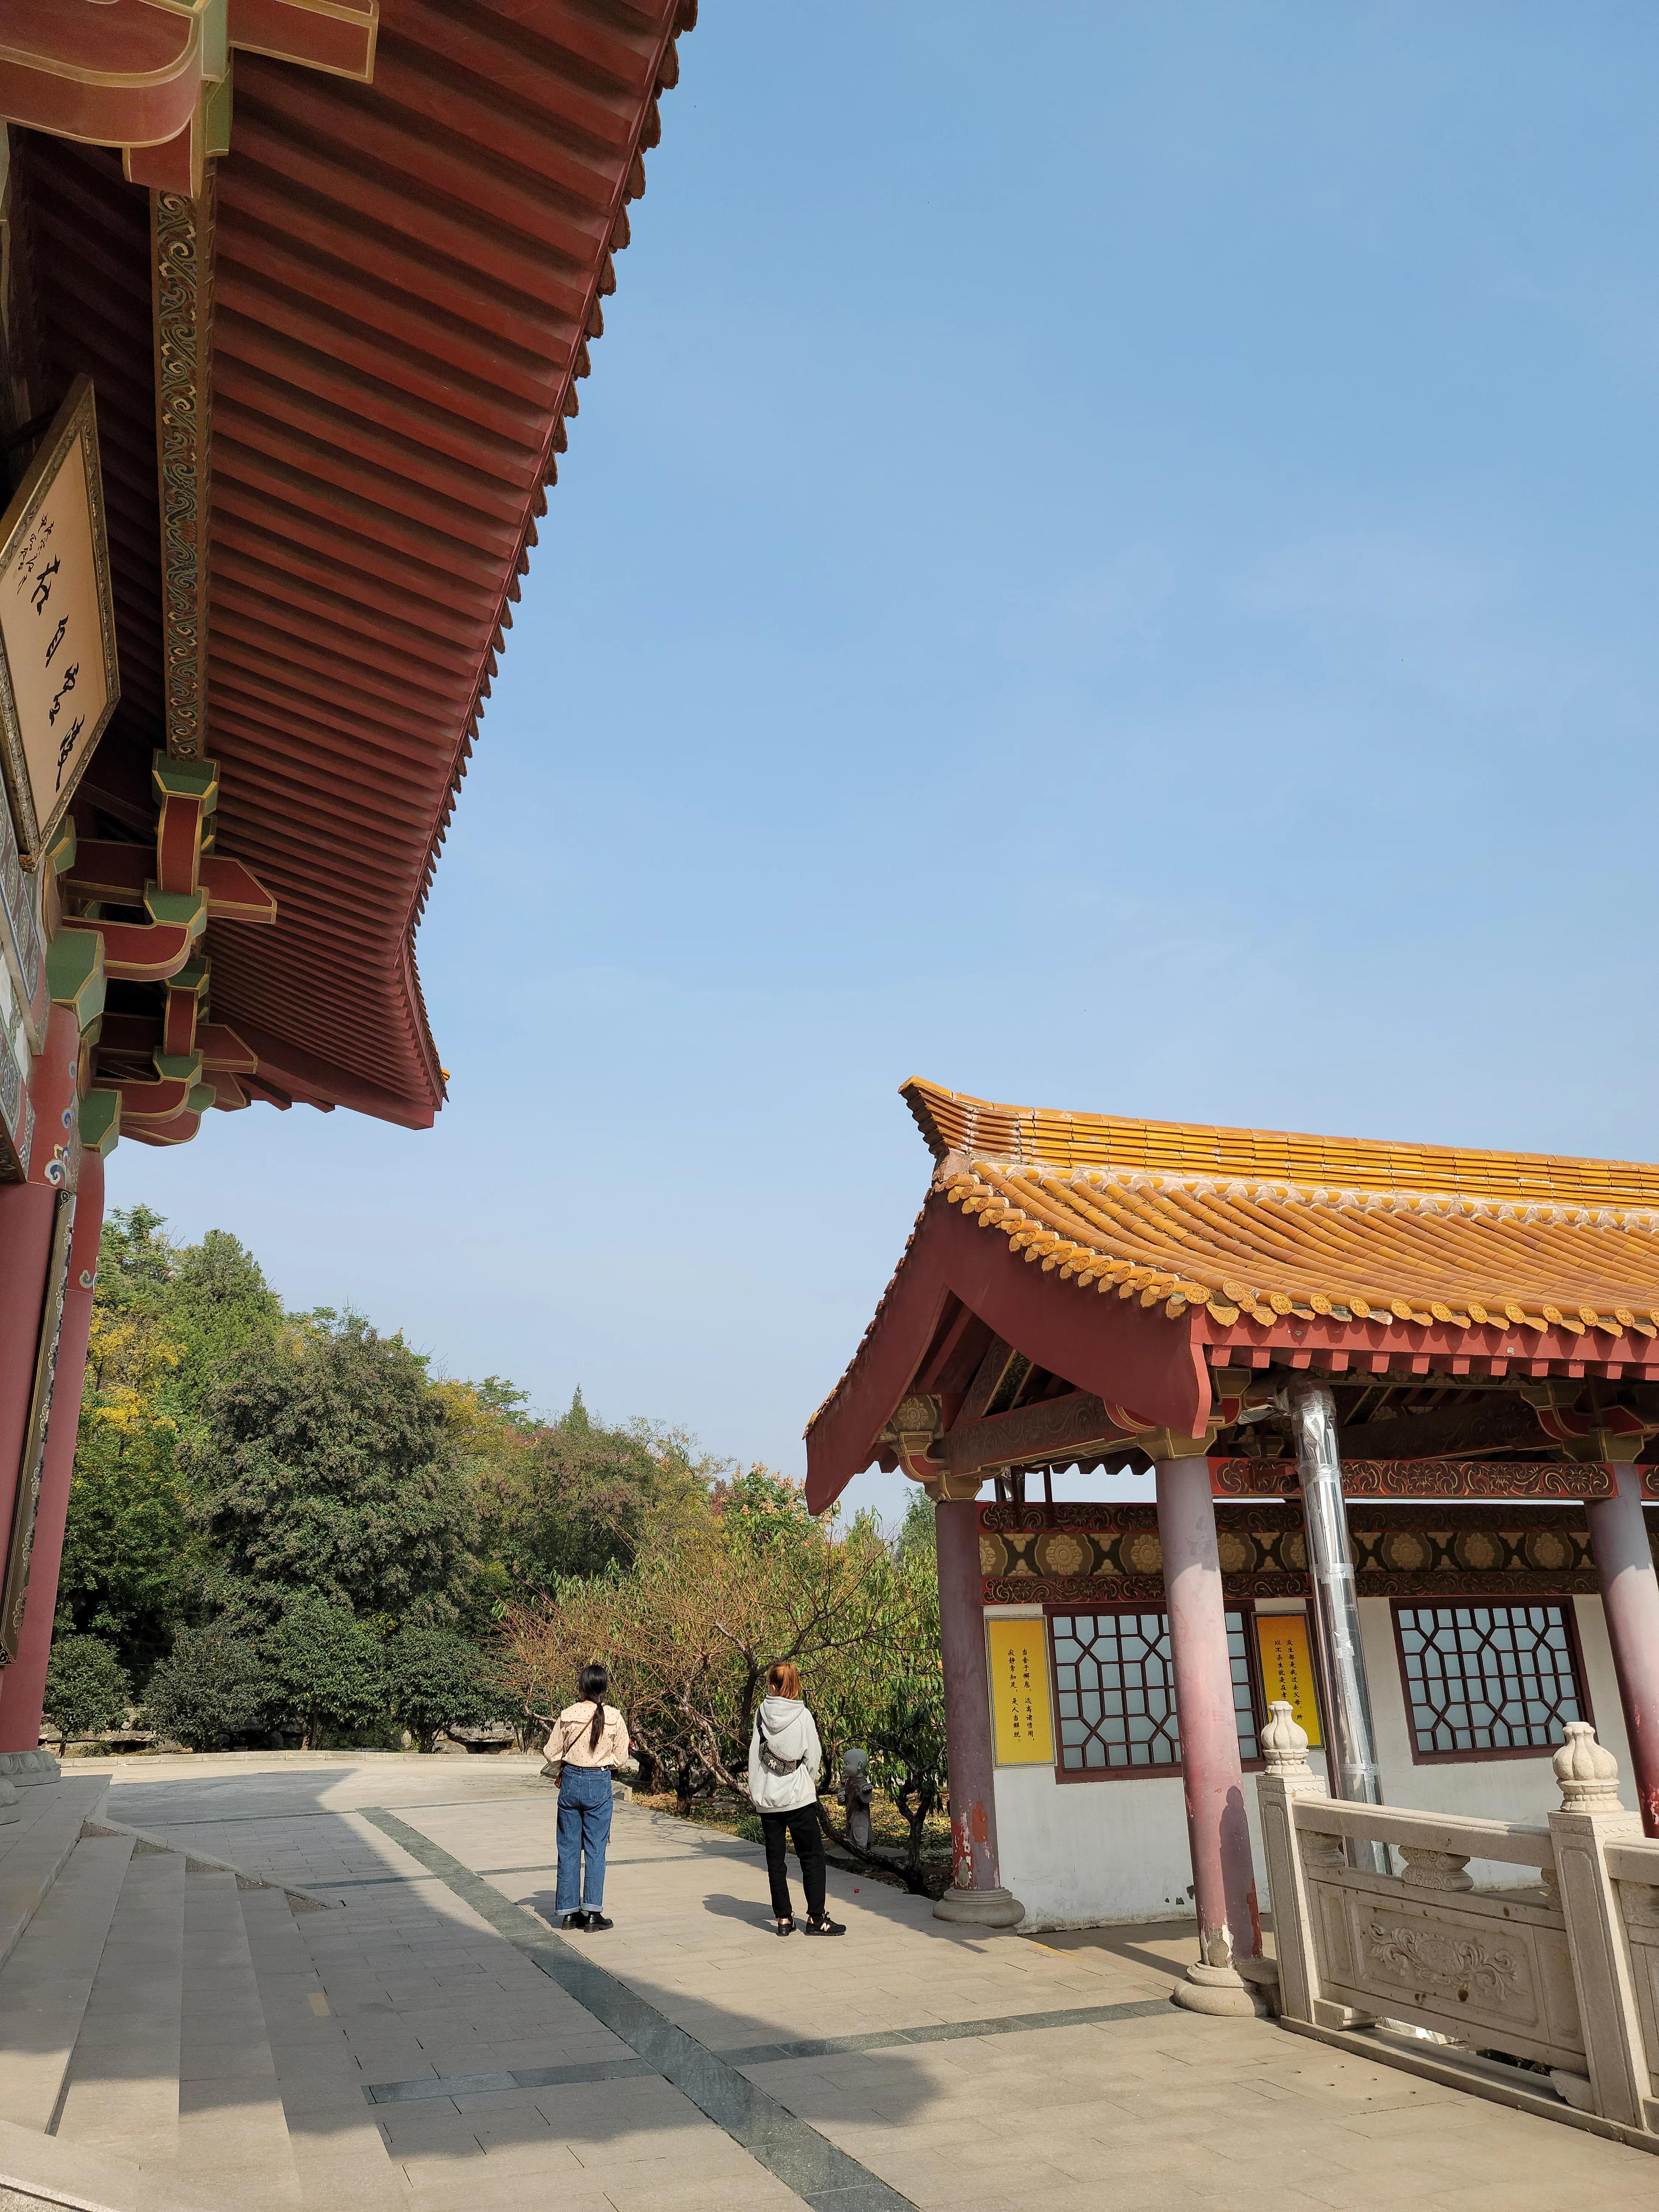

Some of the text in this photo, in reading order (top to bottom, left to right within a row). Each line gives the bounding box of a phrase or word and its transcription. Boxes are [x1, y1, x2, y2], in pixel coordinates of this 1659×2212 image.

[1274, 1640, 1287, 1701] 以不杀生就是在孝
[1287, 1639, 1302, 1721] 众生都是我过去父母，所
[820, 1923, 830, 1931] N
